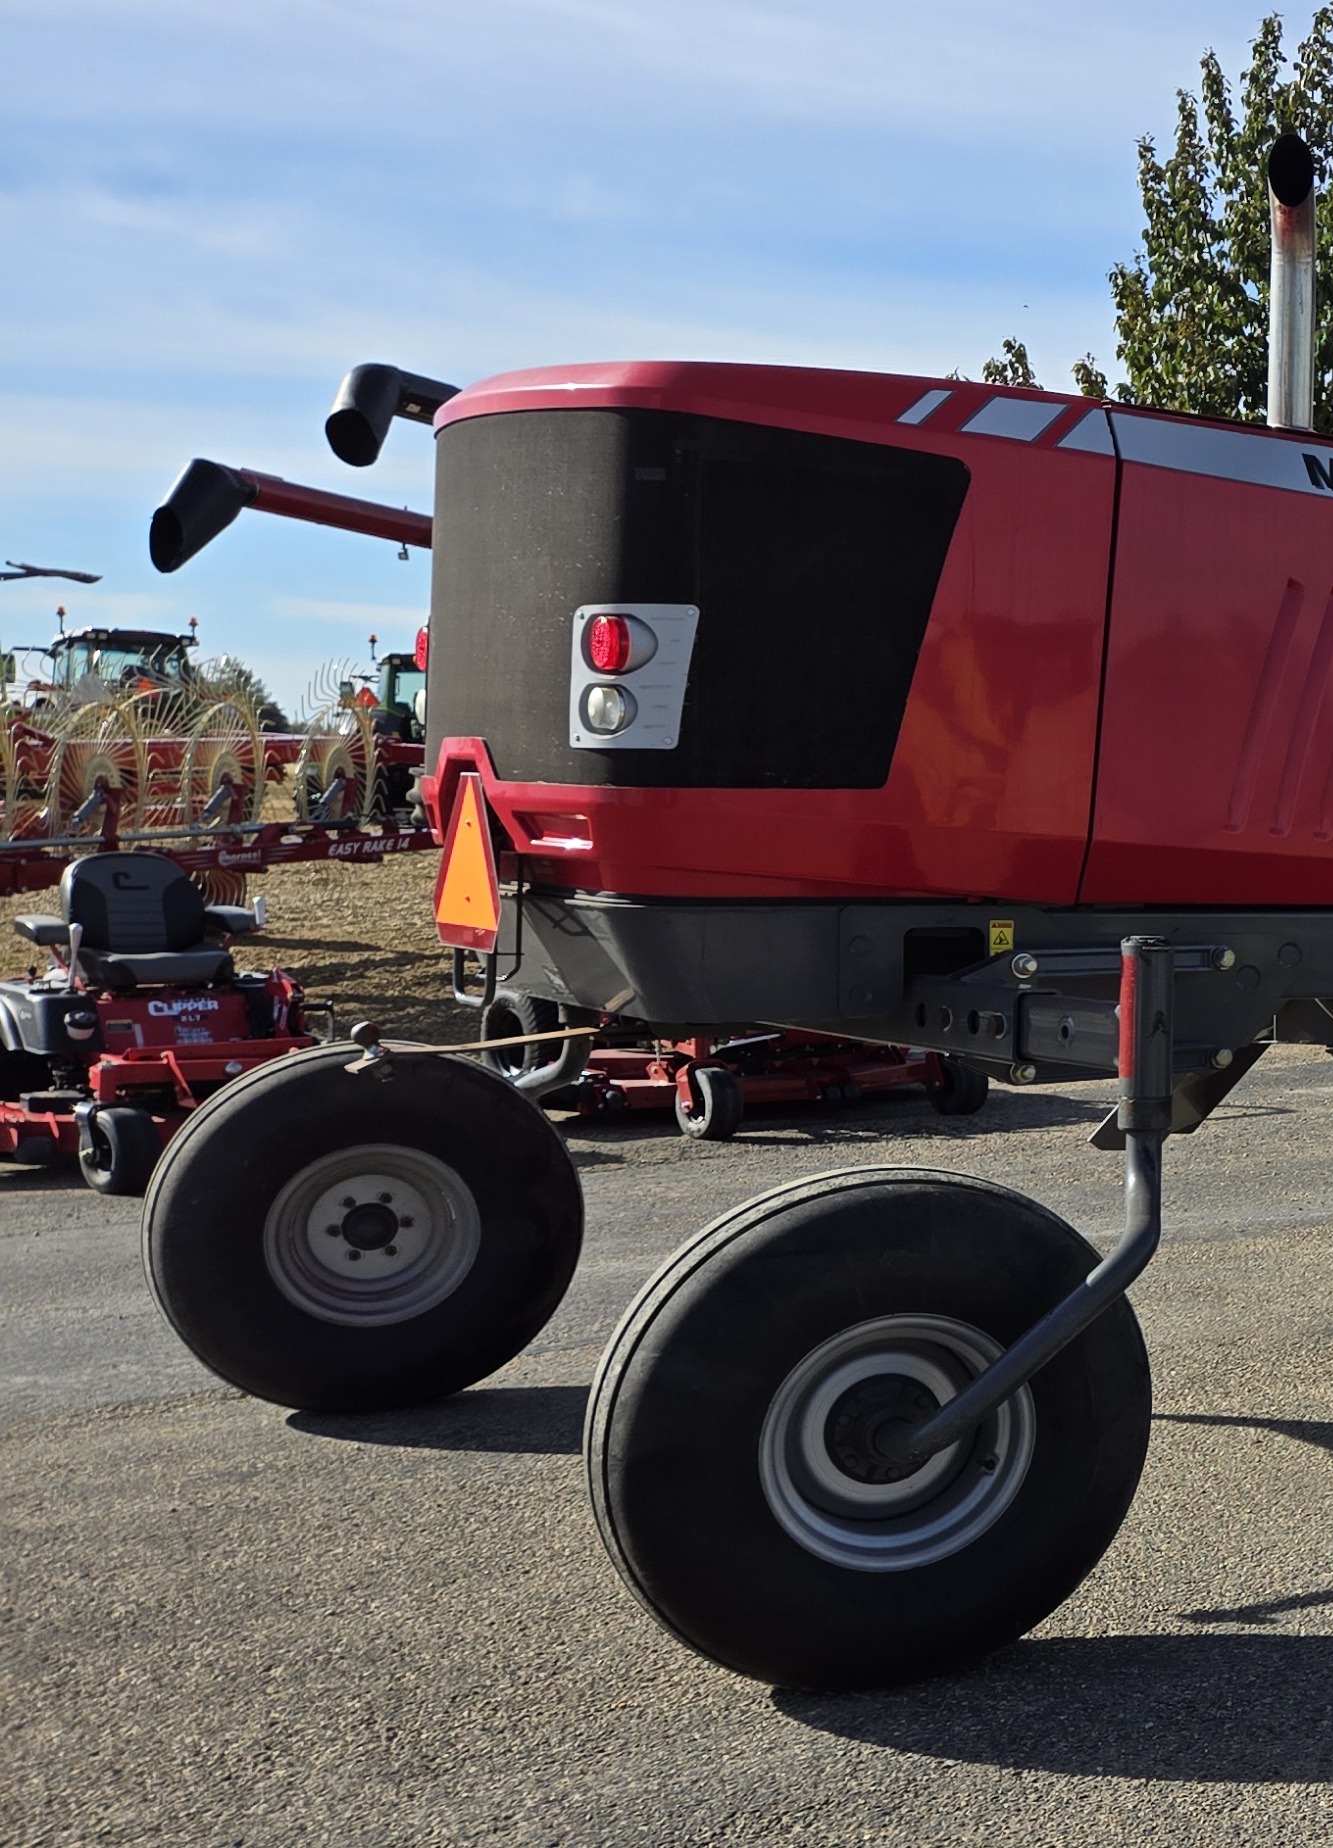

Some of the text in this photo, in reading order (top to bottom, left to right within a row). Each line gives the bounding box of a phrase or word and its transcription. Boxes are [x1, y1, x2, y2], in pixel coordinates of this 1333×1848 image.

[328, 837, 410, 857] EASY RAKE 14
[148, 999, 220, 1017] CLIPPER
